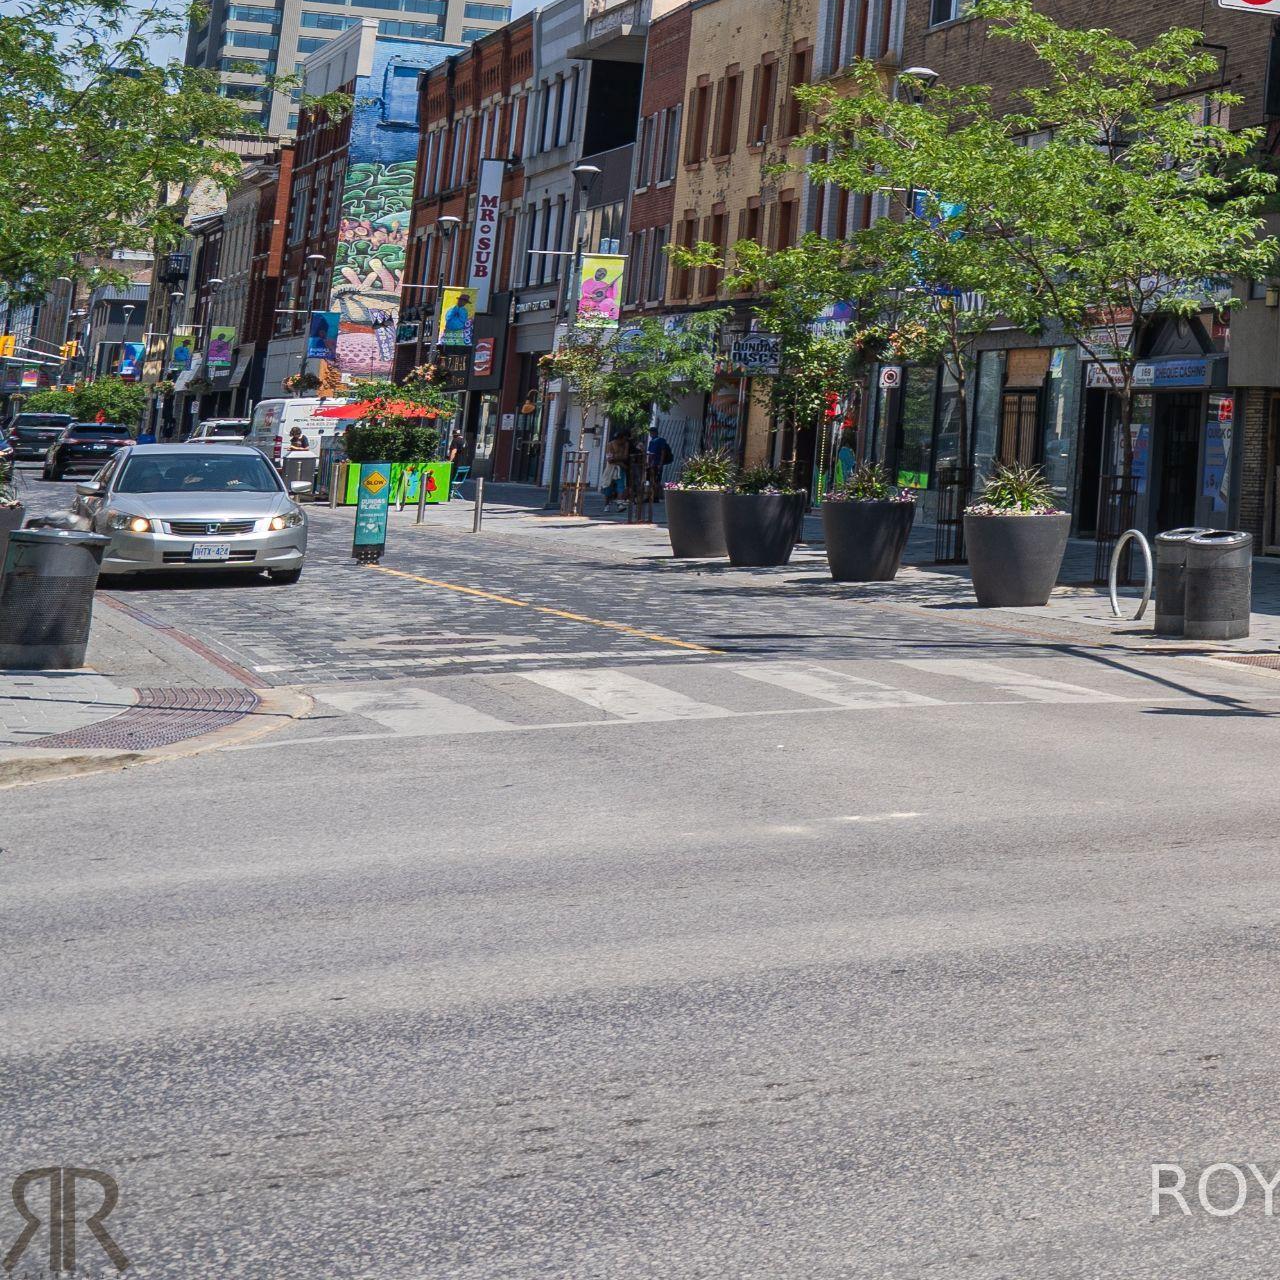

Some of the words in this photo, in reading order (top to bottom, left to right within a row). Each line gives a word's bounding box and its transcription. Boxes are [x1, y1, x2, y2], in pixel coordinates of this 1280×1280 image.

[480, 195, 498, 221] MR
[473, 237, 491, 277] SUB
[733, 341, 780, 353] DUNDAS
[733, 352, 779, 364] DISCS
[1155, 367, 1178, 379] CHEQUE
[1179, 366, 1206, 378] CASHING
